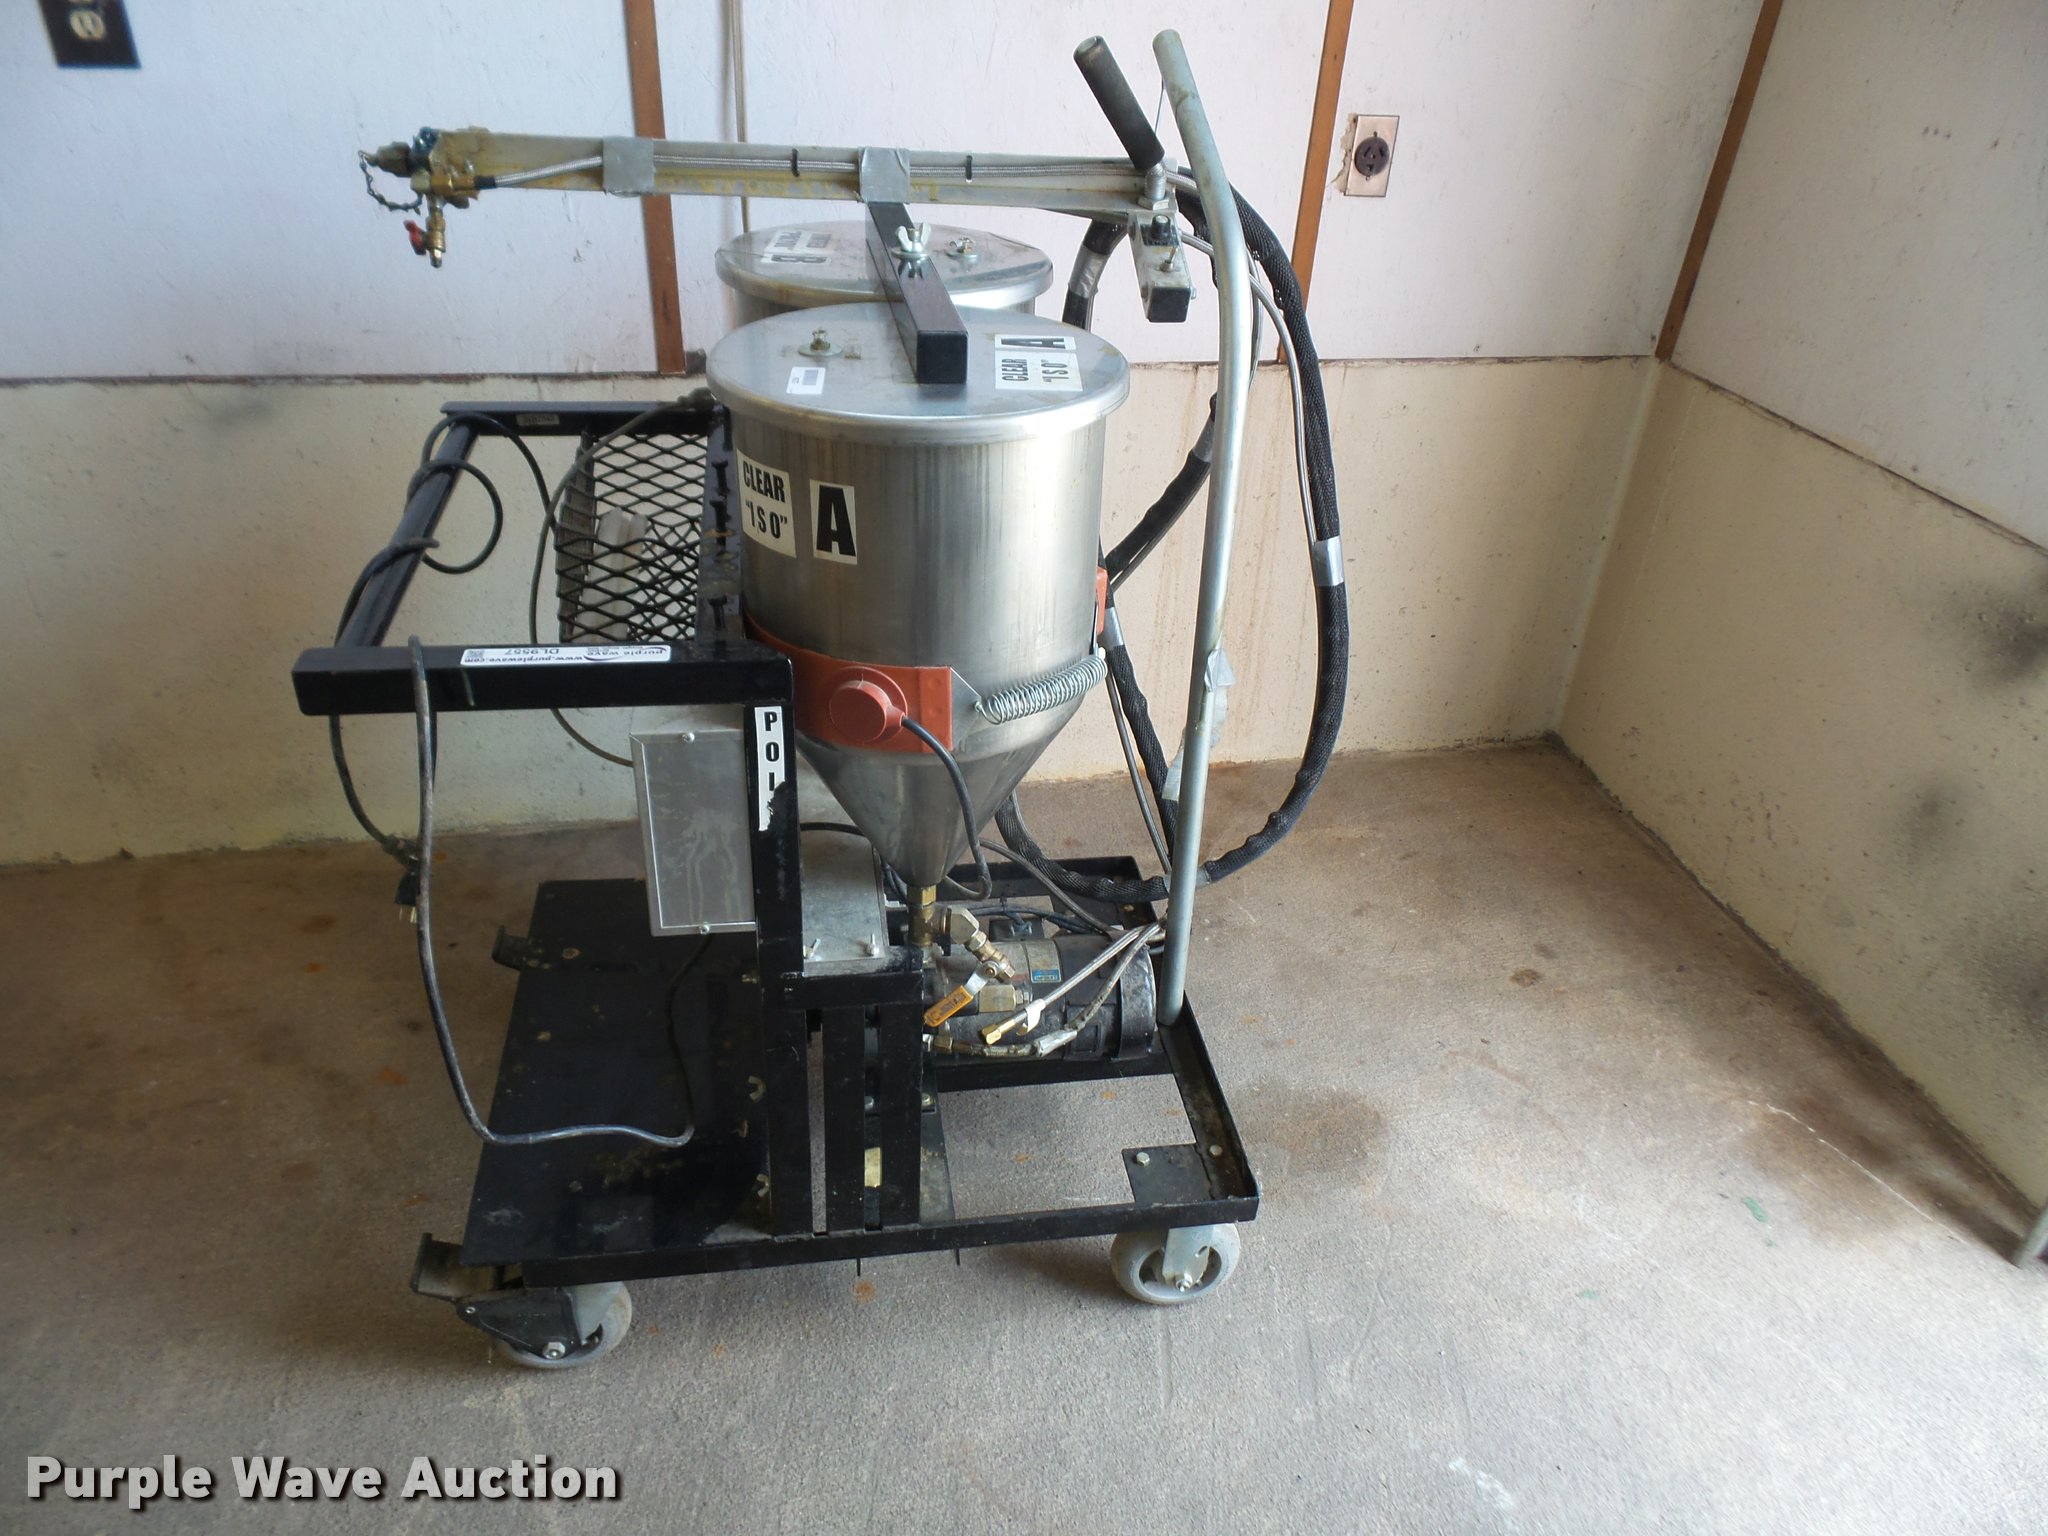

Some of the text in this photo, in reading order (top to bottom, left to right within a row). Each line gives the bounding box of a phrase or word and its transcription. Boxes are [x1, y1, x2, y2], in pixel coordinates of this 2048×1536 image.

[1000, 337, 1066, 349] A
[1001, 358, 1029, 381] CLEAR
[742, 460, 786, 503] CLEAR
[815, 484, 857, 558] A
